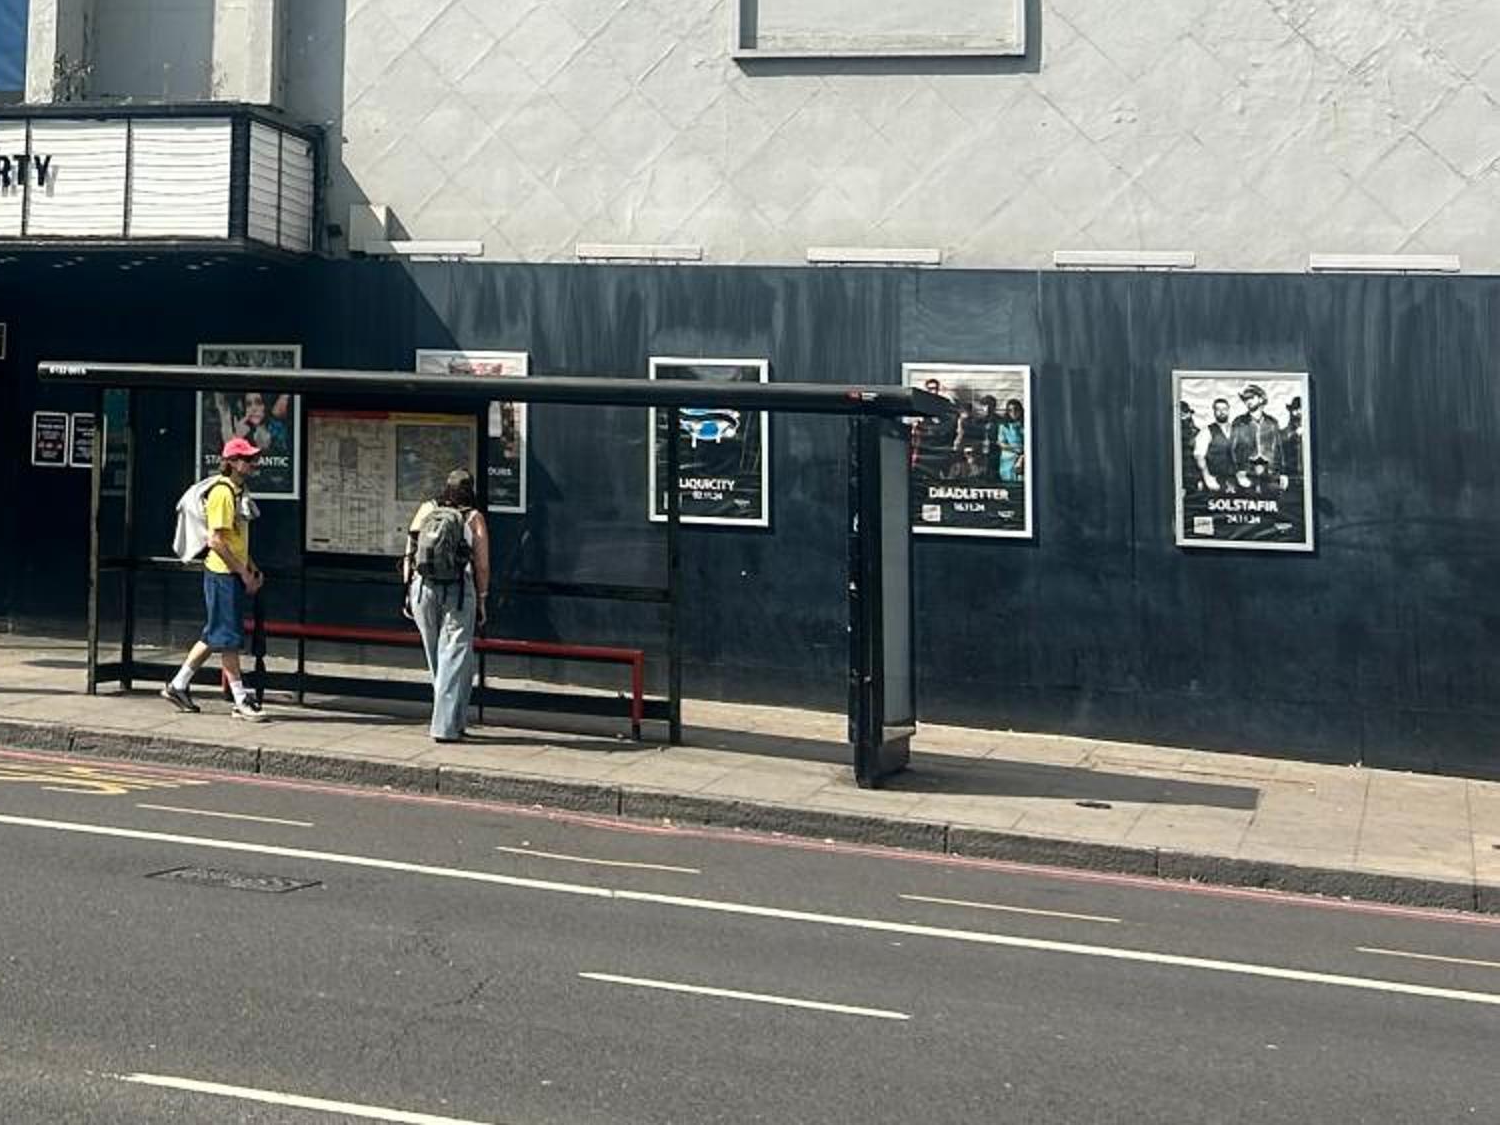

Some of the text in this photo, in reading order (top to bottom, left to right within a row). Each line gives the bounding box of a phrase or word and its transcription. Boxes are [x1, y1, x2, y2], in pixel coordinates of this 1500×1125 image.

[679, 478, 735, 491] LIQUICITY
[929, 487, 1009, 501] DEADLETTER
[1207, 499, 1279, 512] SOLSTAFIR
